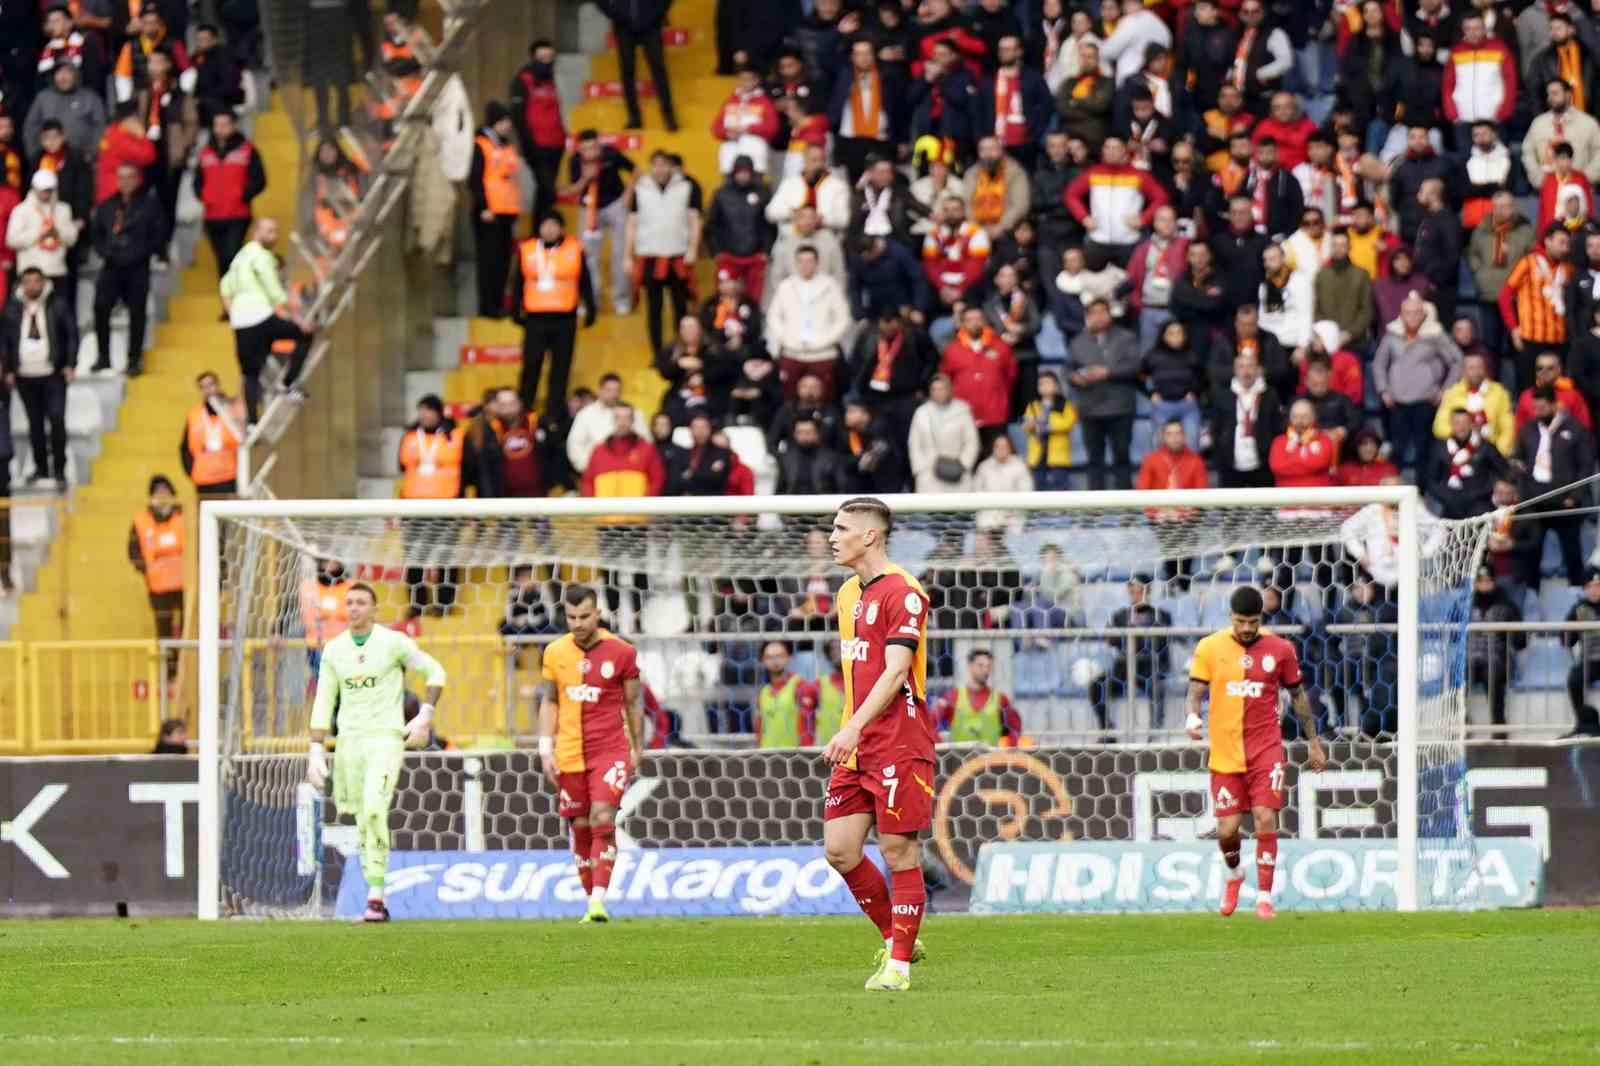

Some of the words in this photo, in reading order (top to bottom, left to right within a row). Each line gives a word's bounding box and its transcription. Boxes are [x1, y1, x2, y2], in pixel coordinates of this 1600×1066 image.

[603, 766, 626, 790] 42
[882, 778, 899, 808] 7
[986, 853, 1143, 902] HDI
